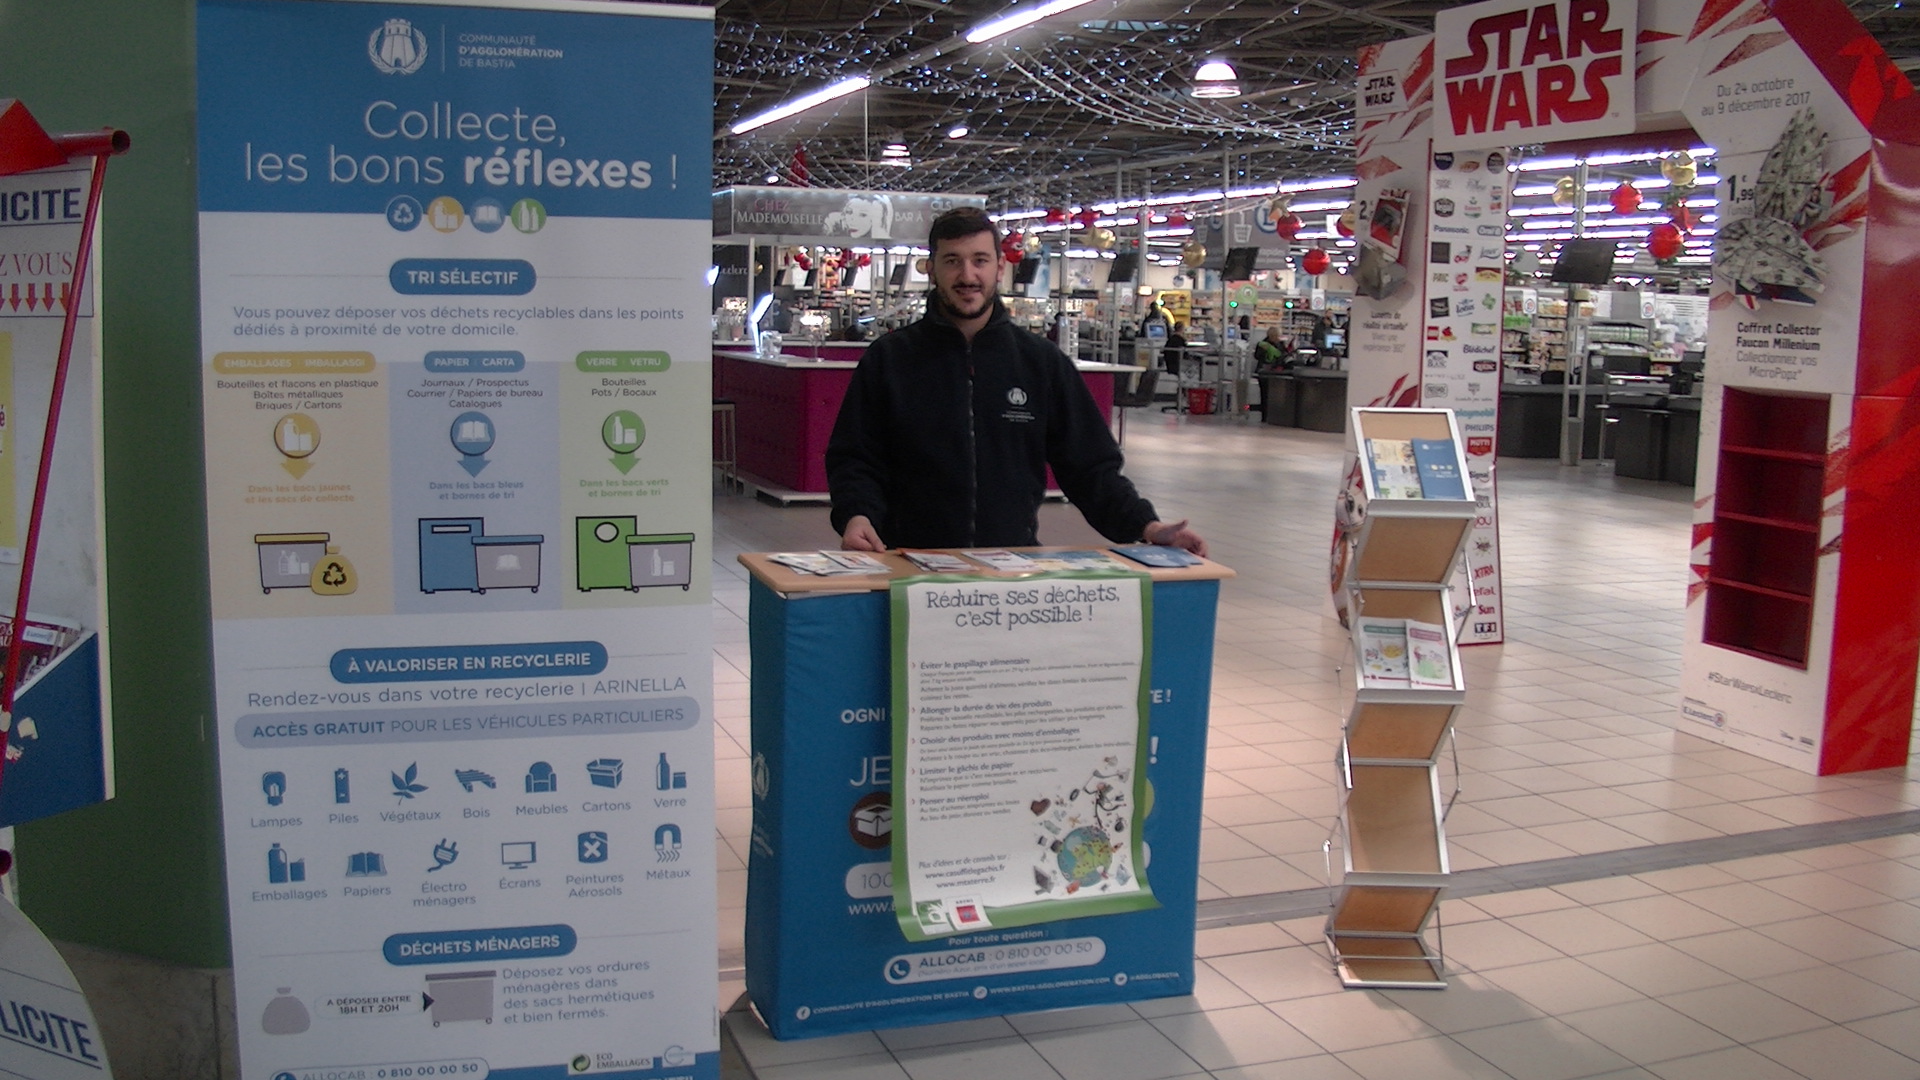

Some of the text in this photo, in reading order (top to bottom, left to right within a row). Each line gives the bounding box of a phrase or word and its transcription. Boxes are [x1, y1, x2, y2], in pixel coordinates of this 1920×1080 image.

[459, 33, 537, 46] COMMUNAUTÉ
[1445, 0, 1624, 79] STAR
[459, 46, 564, 59] D'AGGLOMÉRATION
[459, 58, 516, 69] DE BASTIA
[1365, 75, 1395, 91] STAR
[1717, 78, 1795, 98] Du 24 octobre
[1365, 92, 1395, 106] WARS
[1445, 55, 1622, 137] WARS
[1701, 106, 1714, 117] au
[1728, 97, 1782, 114] décembre
[1786, 92, 1811, 106] 2017
[364, 100, 567, 148] Collecte,
[245, 142, 653, 190] les bons réflexes
[736, 211, 822, 225] MADEMOISELLE
[13, 252, 73, 276] VOUS
[407, 267, 519, 285] TRI SÉLECTIF
[233, 306, 684, 323] Vous pouvez déposer vos déchets recyclables dans les points
[233, 323, 519, 338] dédiés à proximité de votre domicile.
[1737, 322, 1822, 336] Coffret Collector
[1736, 336, 1821, 351] Faucon Millenium
[434, 358, 515, 367] PAPIER CARTA
[586, 358, 661, 366] VERRE VETRU
[1736, 351, 1818, 366] Collectionnez vos
[216, 380, 265, 389] Bouteilles
[268, 380, 278, 388] et
[281, 380, 317, 388] flacons
[334, 380, 379, 390] plastique
[421, 379, 529, 388] Journaux Prospectus
[602, 378, 646, 386] Bouteilles
[253, 390, 344, 400] Boîtes métalliques
[407, 389, 543, 398] Courrier Papiers de bureau
[591, 389, 657, 397] Pots Bocaux
[255, 401, 342, 411] Briques Cartons
[449, 400, 503, 410] Catalogues
[1465, 424, 1495, 432] PHILIPS
[1474, 565, 1495, 580] XTRA
[926, 585, 1120, 609] Réduire ses déchets,
[1478, 605, 1495, 614] Sun
[955, 609, 1002, 627] c'est
[1008, 606, 1082, 630] possible
[348, 653, 591, 673] À VALORISER EN RECYCLERIE
[248, 677, 687, 707] Rendez-vous dans votre recyclerie ARINELLA
[253, 708, 684, 738] ACCÈS GRATUIT POUR LES VÉHICULES PARTICULIERS
[841, 708, 885, 724] OGNI
[516, 804, 568, 815] Meubles
[582, 801, 631, 813] Cartons
[654, 798, 687, 808] Verre
[329, 813, 359, 823] Piles
[380, 811, 441, 823] Végétaux
[463, 808, 491, 818] Bois
[251, 817, 303, 829] Lampes
[566, 874, 624, 885] Peintures
[646, 868, 691, 880] Métaux
[421, 881, 467, 894] Électro
[499, 877, 541, 889] Écrans
[253, 889, 328, 903] Emballages
[344, 886, 392, 898] Papiers
[568, 886, 622, 898] Aérosols
[413, 895, 476, 908] ménagers
[949, 930, 1044, 947] Pour toute question
[400, 935, 561, 957] DÉCHETS MÉNAGERS
[919, 952, 986, 969] ALLOCAB
[1077, 942, 1093, 953] 50
[503, 961, 650, 981] Déposez vos ordures
[503, 978, 618, 996] ménagères dans
[503, 990, 655, 1010] des sacs hermétiques
[504, 1008, 609, 1024] et bien fermés.
